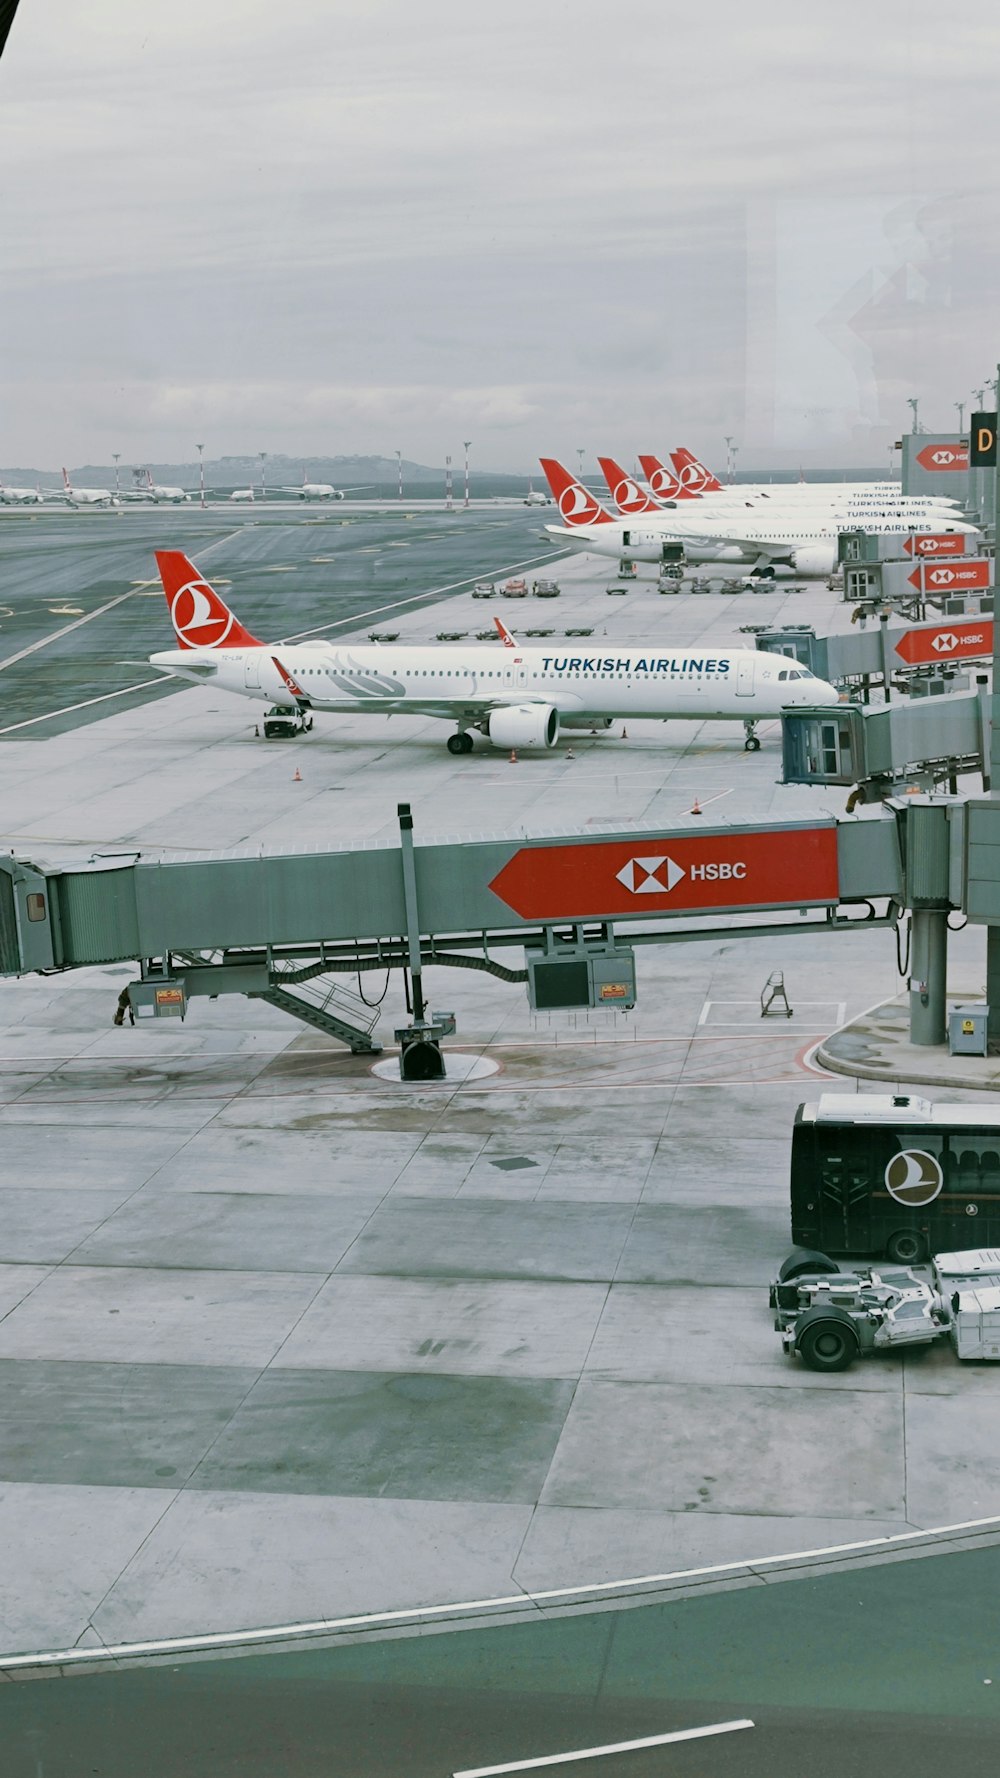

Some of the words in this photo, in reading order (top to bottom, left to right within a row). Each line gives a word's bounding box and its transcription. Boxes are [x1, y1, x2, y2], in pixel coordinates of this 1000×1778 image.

[978, 428, 993, 452] D
[956, 571, 977, 579] HSBC
[960, 634, 984, 645] HSBC
[542, 658, 631, 672] TURKISH
[633, 658, 730, 673] AIRLINES
[690, 861, 747, 881] HSBC
